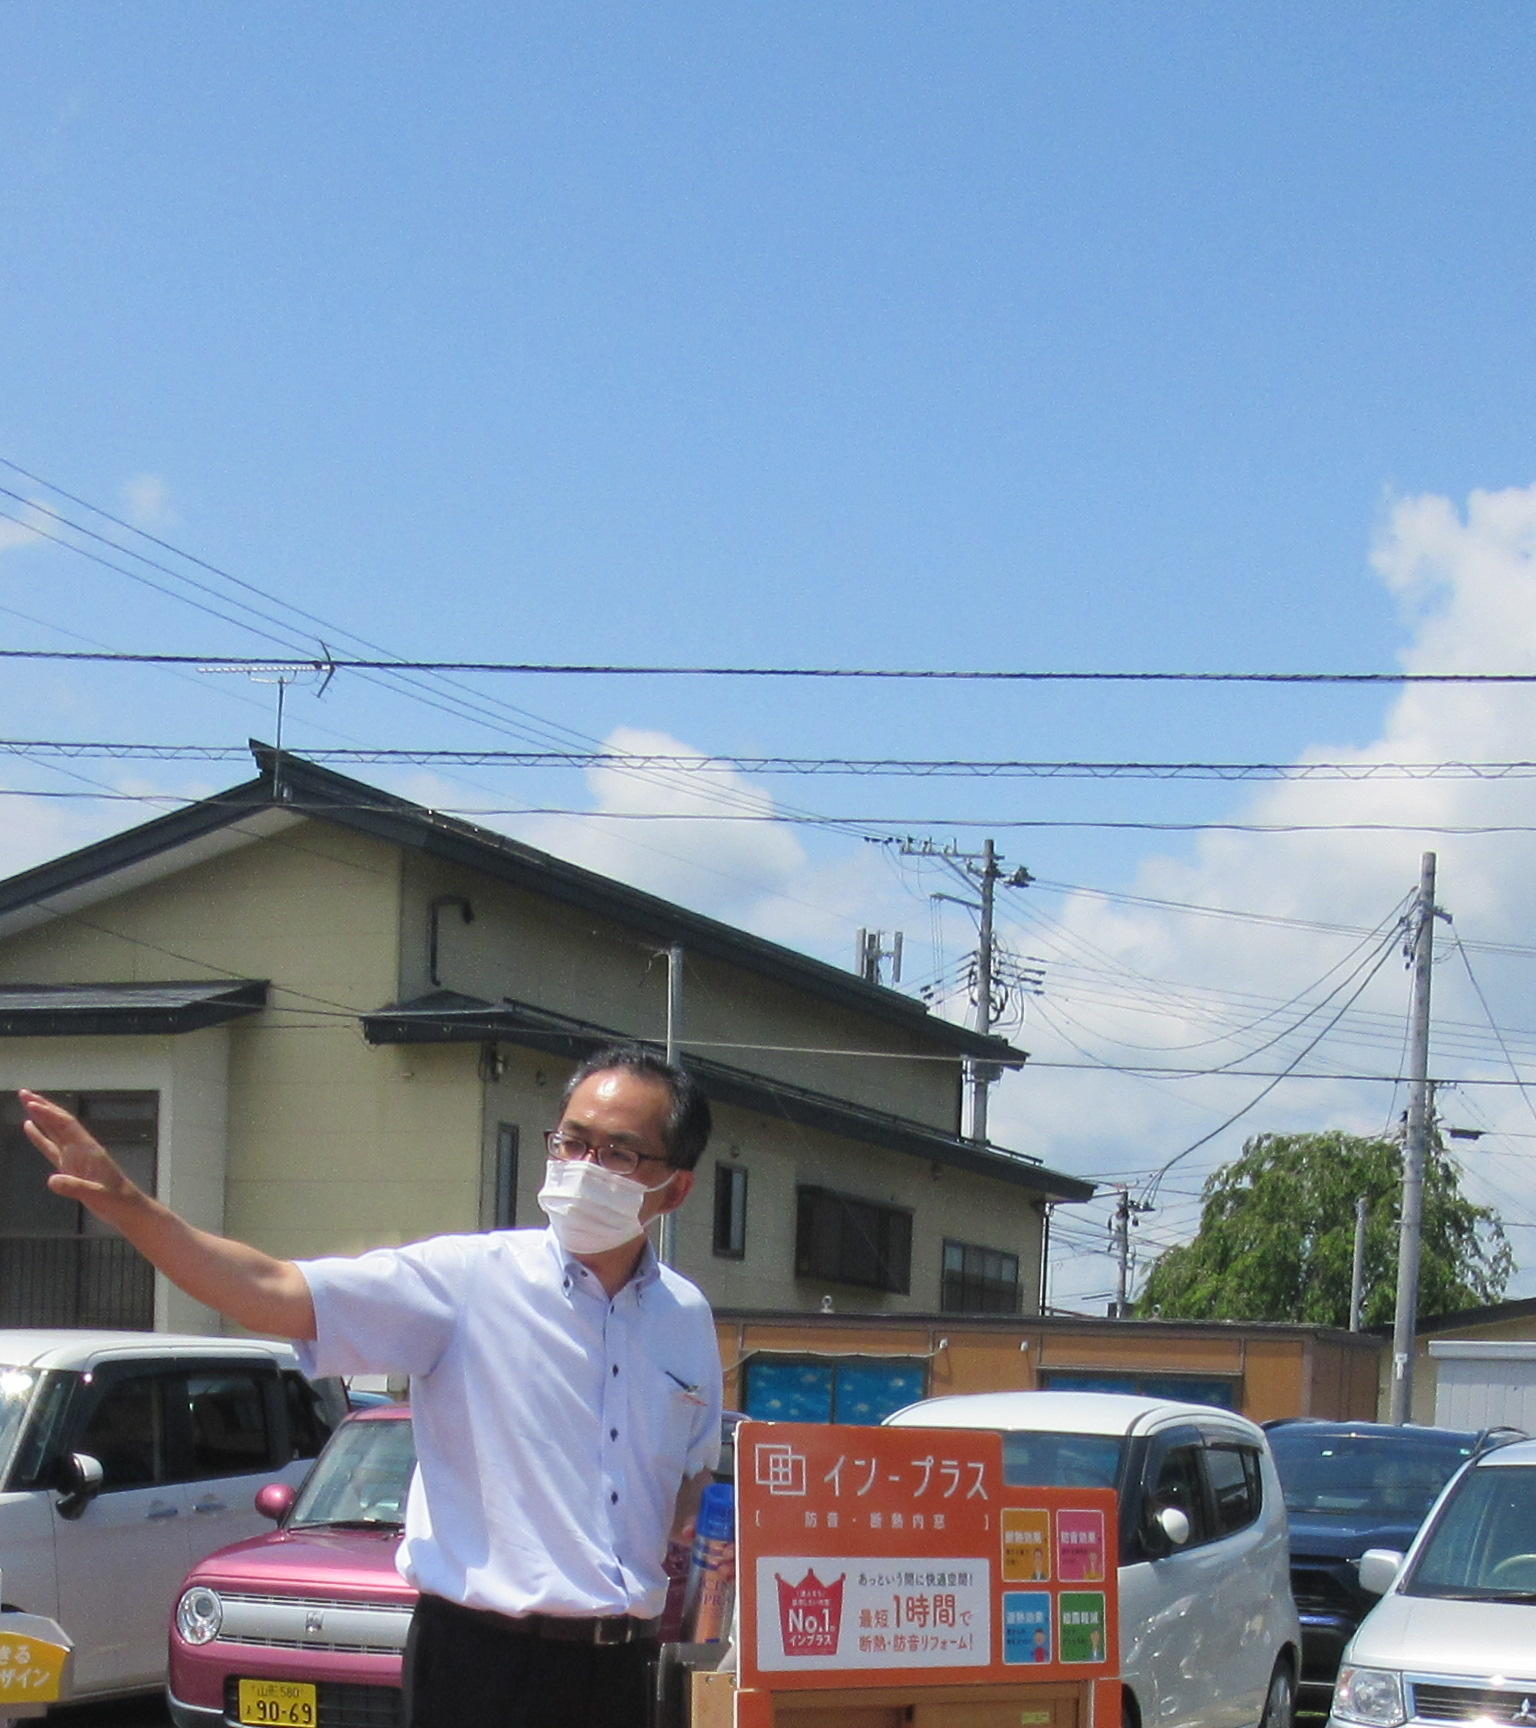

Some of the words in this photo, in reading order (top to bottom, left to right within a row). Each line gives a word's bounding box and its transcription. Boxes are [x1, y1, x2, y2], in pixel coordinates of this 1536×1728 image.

[790, 1634, 833, 1647] インプラス
[257, 1700, 312, 1724] 90-69
